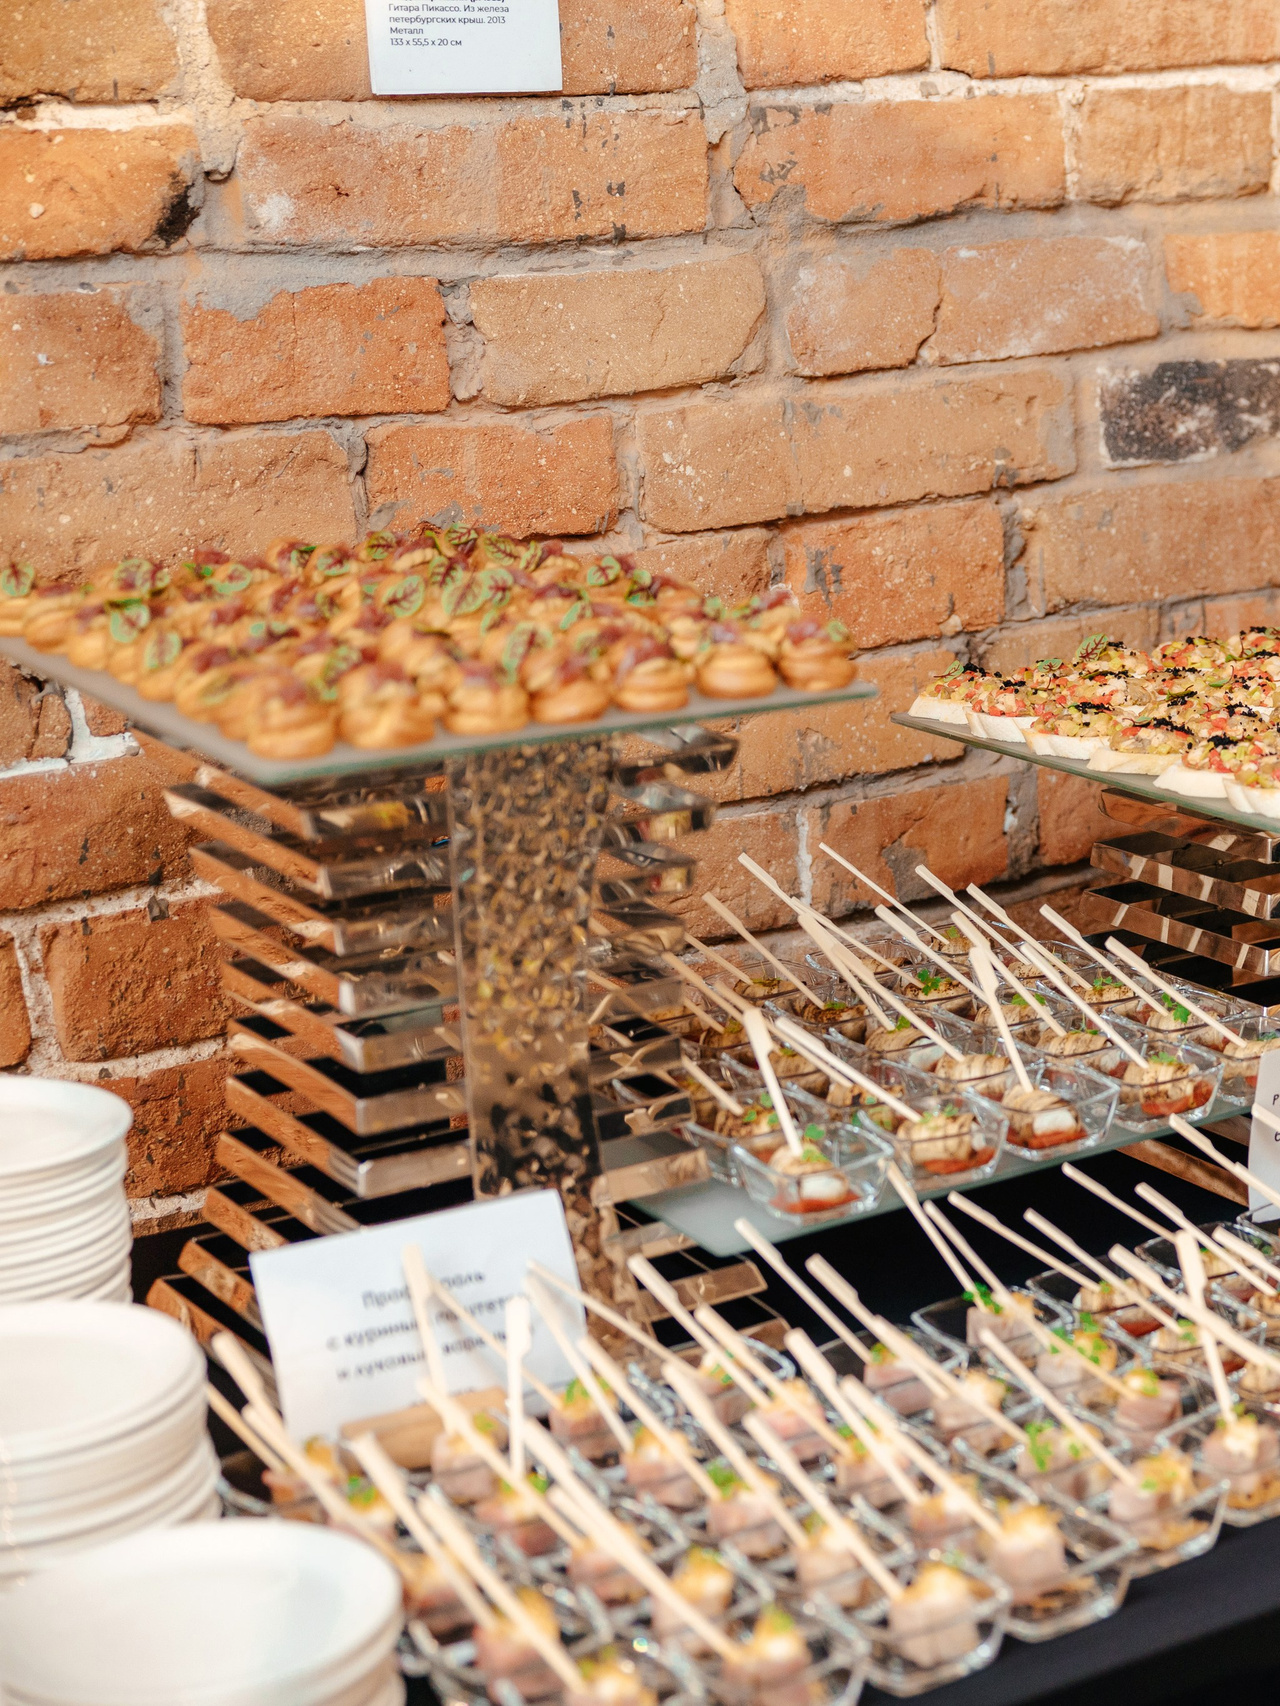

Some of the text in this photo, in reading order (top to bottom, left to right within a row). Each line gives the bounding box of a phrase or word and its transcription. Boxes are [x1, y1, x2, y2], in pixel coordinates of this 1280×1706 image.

[388, 3, 420, 13] Гитара
[421, 3, 462, 13] Пикассо.
[463, 4, 475, 13] Из
[389, 14, 506, 25] петербургских крыш. 2013
[389, 26, 424, 35] Металл
[390, 37, 404, 46] 133
[412, 37, 430, 47] 55,5
[437, 38, 449, 46] 20
